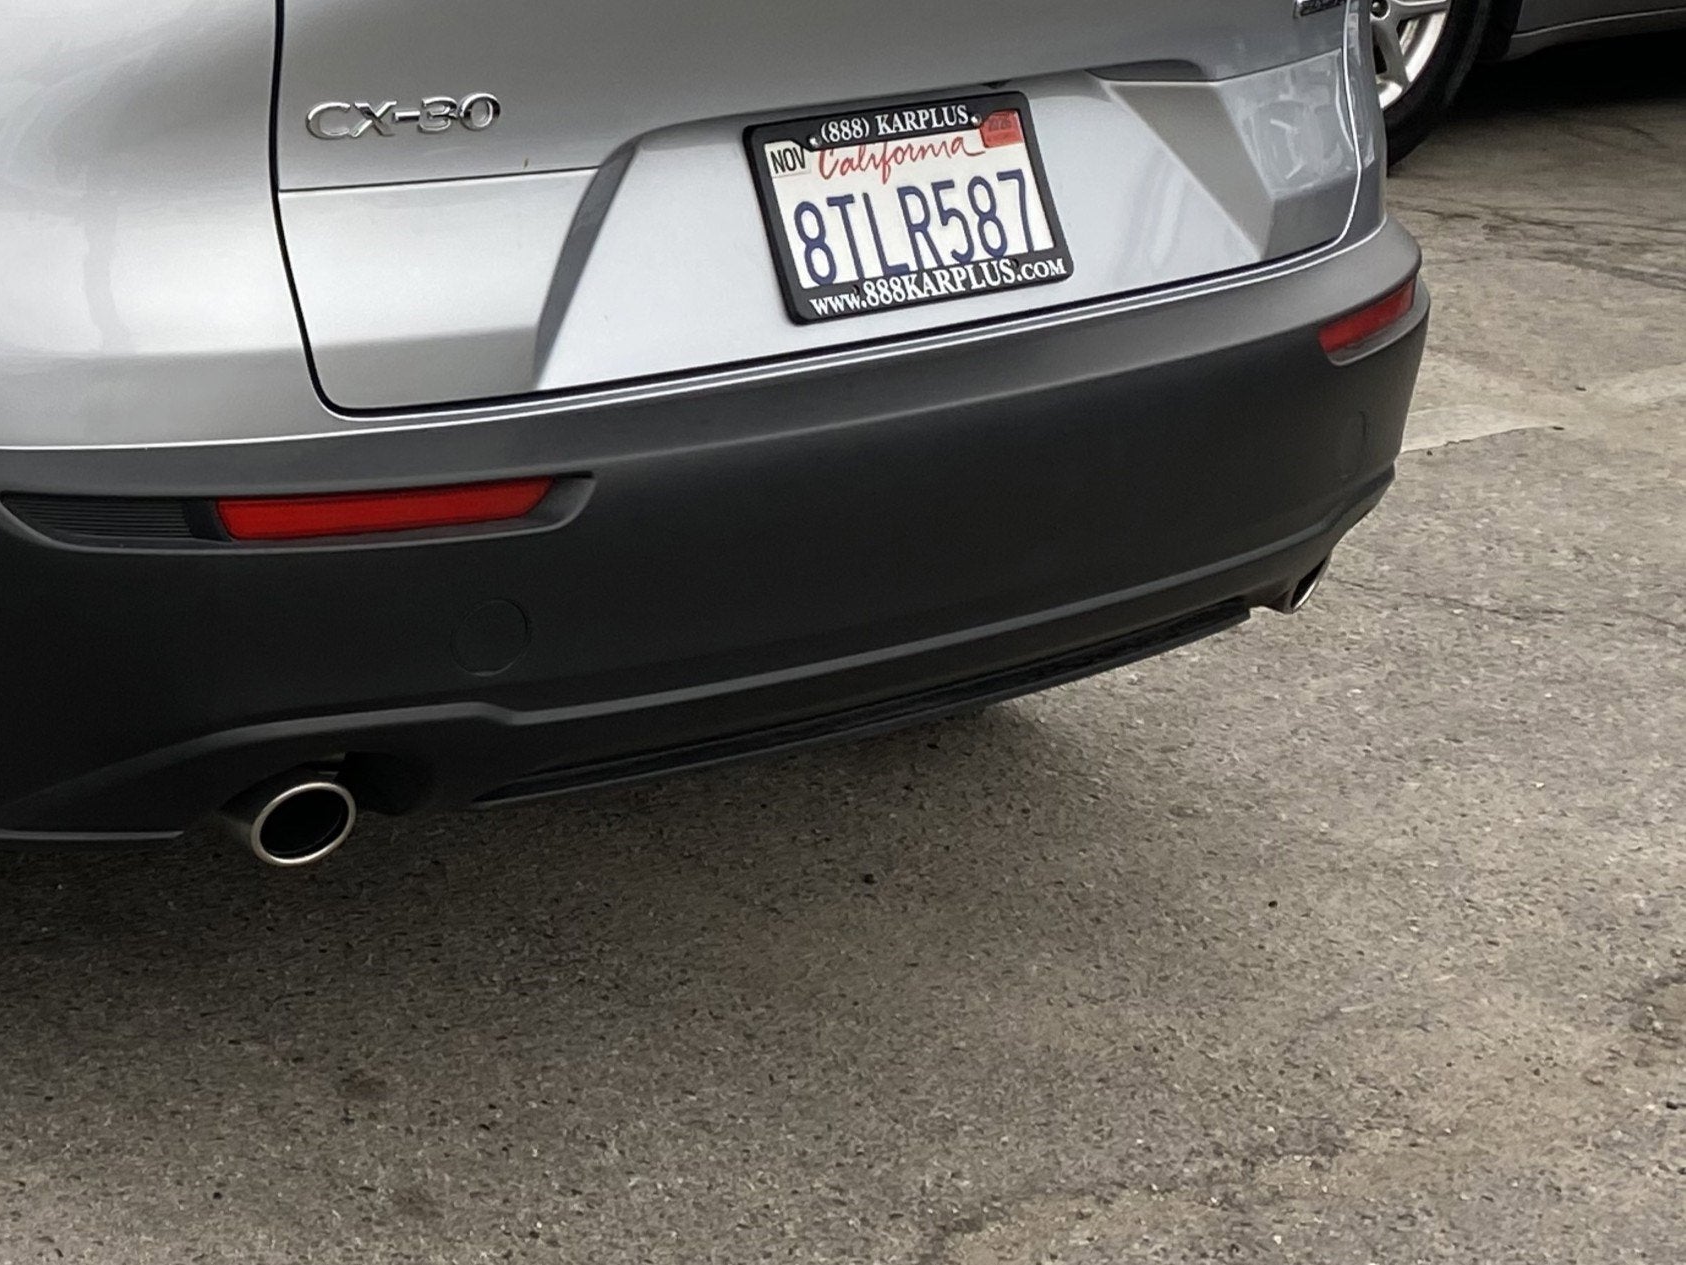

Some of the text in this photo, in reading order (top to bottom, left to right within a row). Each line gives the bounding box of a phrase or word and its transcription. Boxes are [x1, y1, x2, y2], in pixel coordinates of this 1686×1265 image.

[305, 92, 502, 141] CX-30
[820, 115, 871, 144] (888)
[874, 104, 970, 137] KARPLUS
[769, 135, 985, 185] NOV California
[793, 168, 1036, 287] 8TLR587
